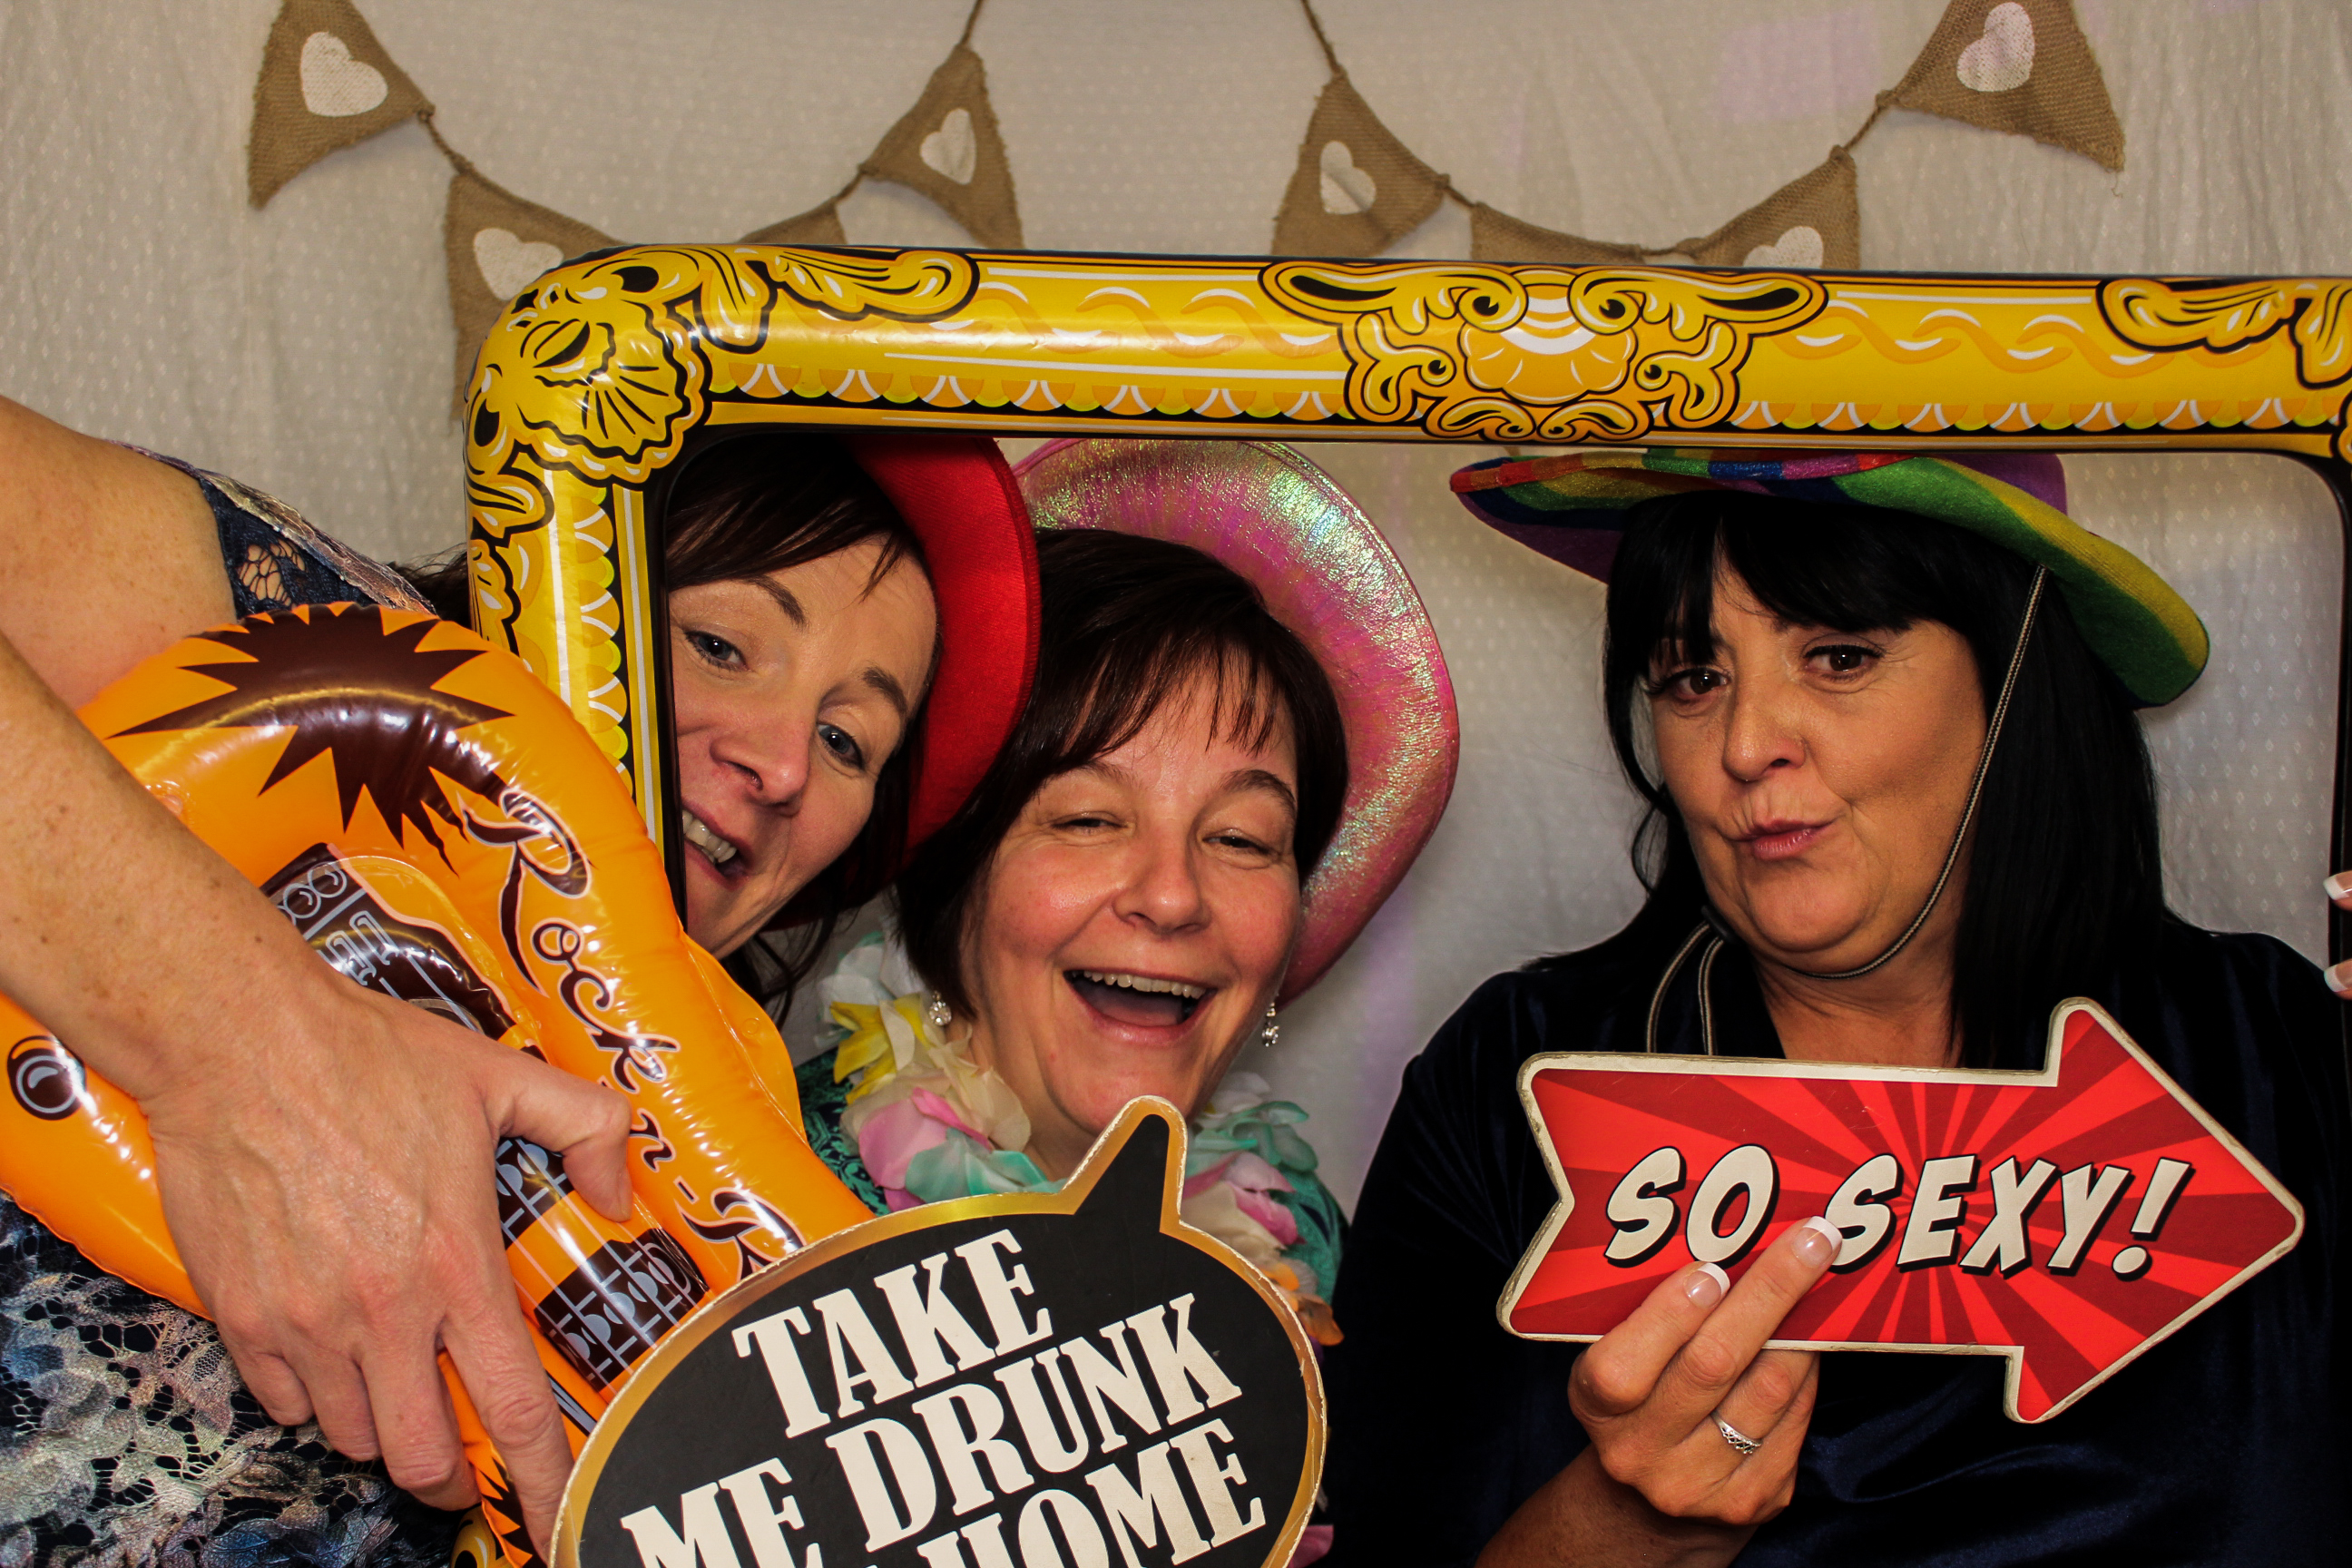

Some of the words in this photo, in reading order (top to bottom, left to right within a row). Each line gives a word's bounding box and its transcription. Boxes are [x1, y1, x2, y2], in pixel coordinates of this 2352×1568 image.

[1604, 1144, 1779, 1267] SO
[1825, 1153, 2191, 1279] SEXY!
[621, 1457, 824, 1568] ME
[825, 1292, 1242, 1553] DRUNK
[731, 1229, 1054, 1438] TAKE
